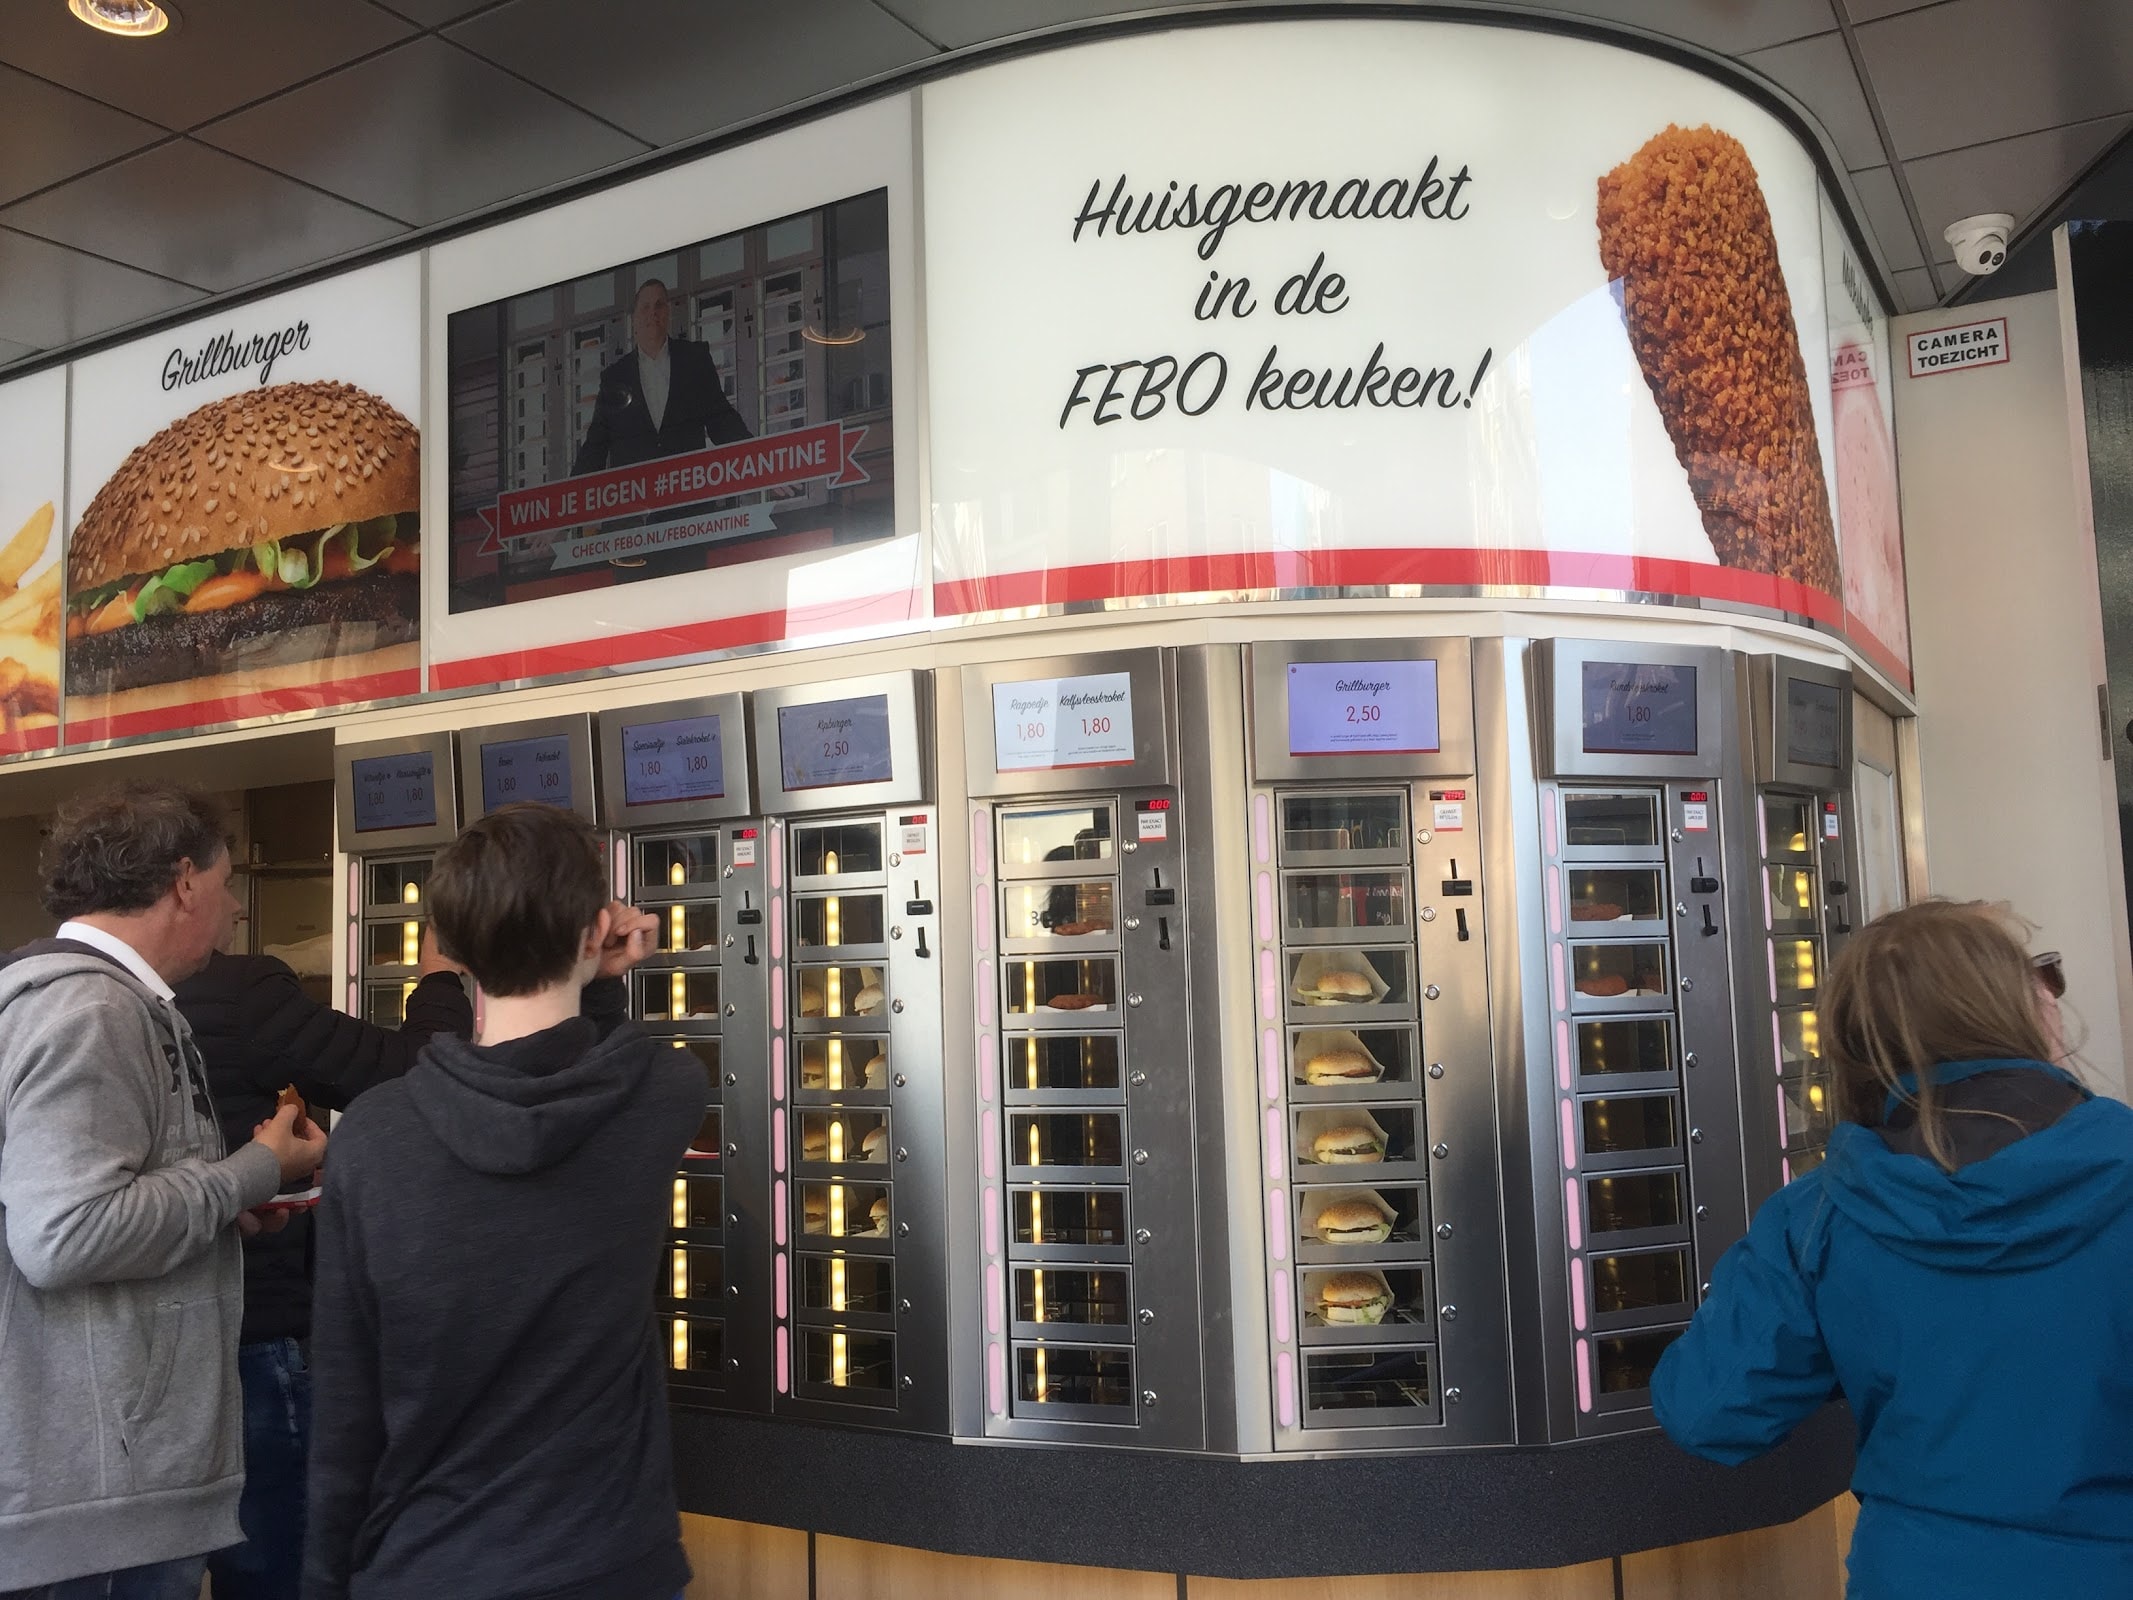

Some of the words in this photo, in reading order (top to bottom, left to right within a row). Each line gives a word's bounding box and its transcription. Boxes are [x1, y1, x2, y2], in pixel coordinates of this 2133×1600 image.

[1073, 155, 1472, 261] Huisgemaakt
[1194, 270, 1257, 320] in
[1274, 251, 1350, 315] de
[1917, 327, 1998, 351] CAMERA
[161, 320, 311, 391] Grillburger
[1917, 344, 2000, 368] TOEZICHT
[1059, 351, 1228, 430] FEBO
[1246, 341, 1492, 411] keuken!
[510, 497, 550, 526] WIN
[557, 491, 578, 517] JE
[585, 477, 646, 511] EIGEN
[653, 439, 827, 497] #FEBOKANTINE
[572, 540, 611, 559] CHECK
[614, 513, 750, 551] FEBO.NL/FEBOKANTINE
[1335, 679, 1391, 697] Grillburger
[1346, 705, 1381, 724] 2,50
[1627, 705, 1651, 723] 1,80
[1016, 722, 1045, 741] 1,80
[1081, 717, 1110, 736] 1,80
[823, 740, 849, 759] 2,50
[640, 760, 661, 777] 1,80
[685, 755, 708, 773] 1,80
[497, 777, 516, 794] 1,80
[540, 772, 559, 790] 1,80
